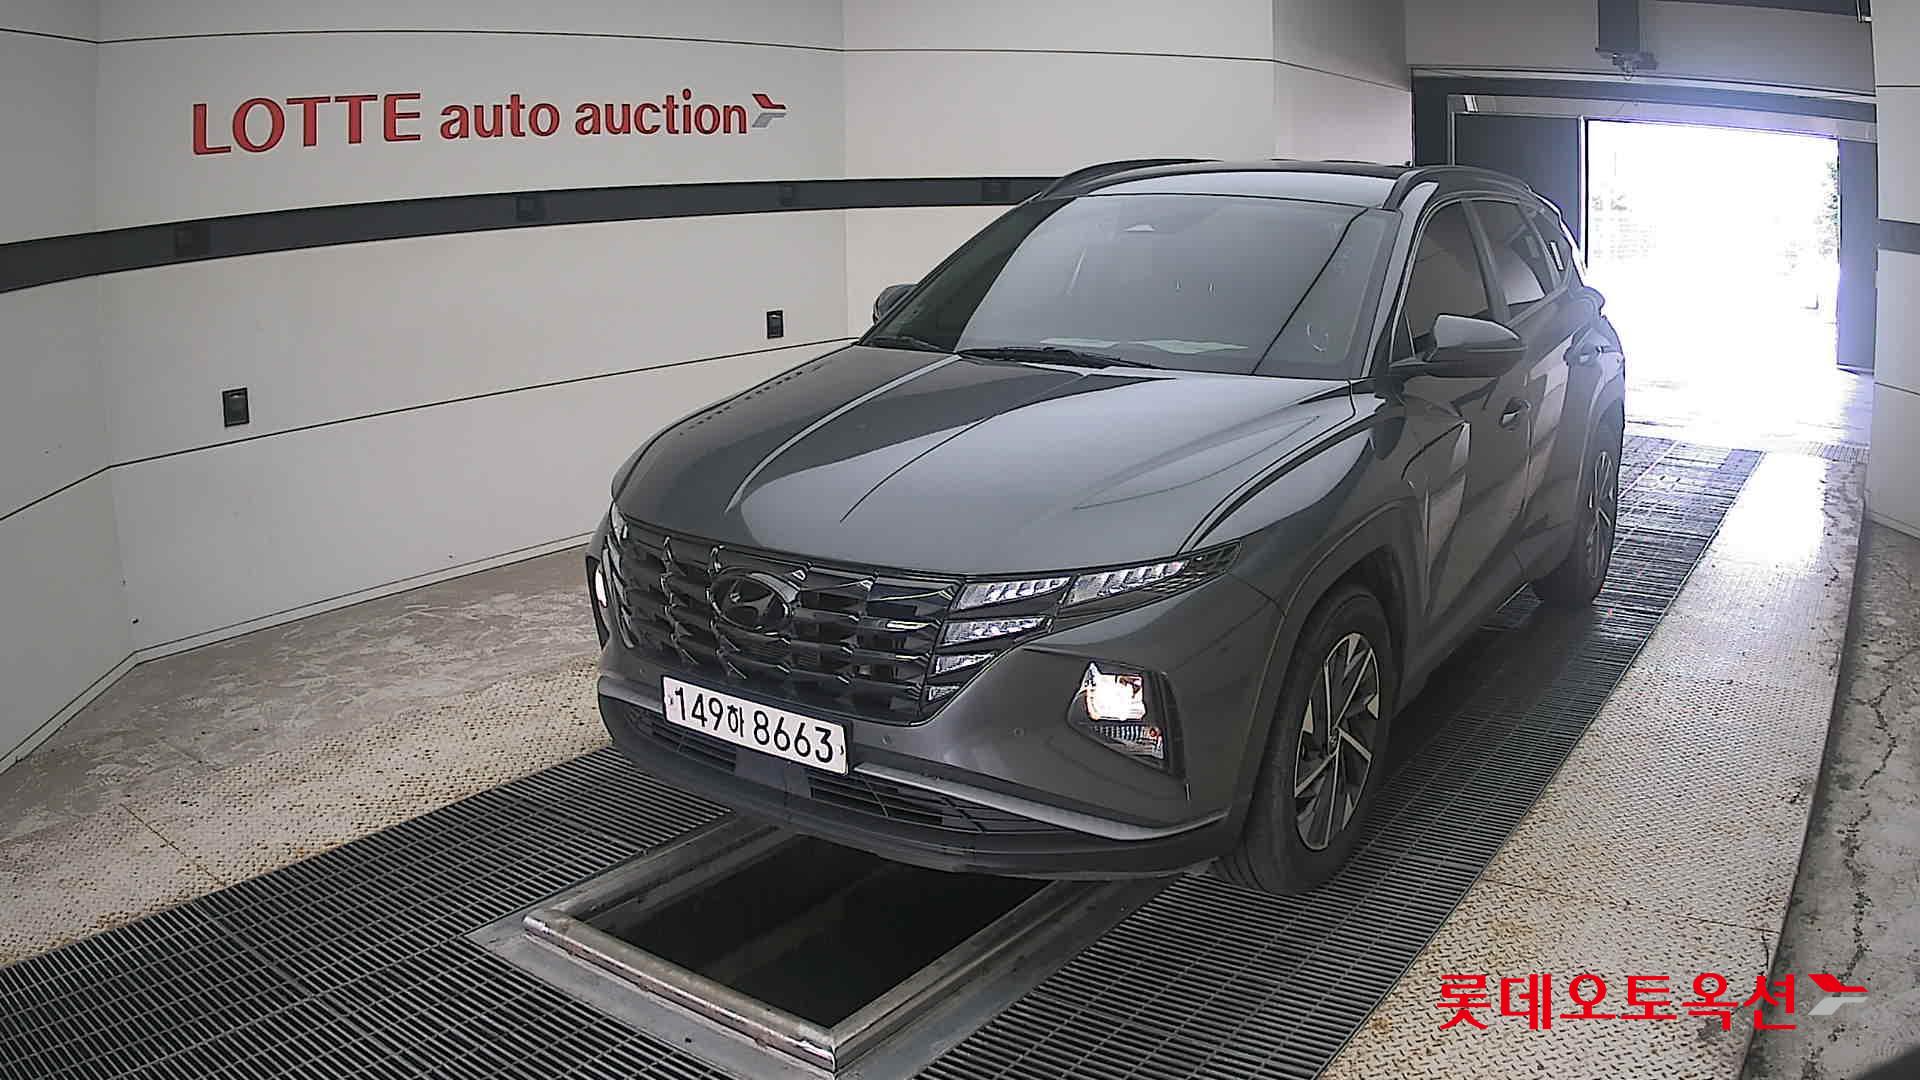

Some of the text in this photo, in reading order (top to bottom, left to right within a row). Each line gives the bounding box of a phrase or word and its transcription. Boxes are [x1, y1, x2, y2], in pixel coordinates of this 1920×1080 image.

[192, 88, 748, 156] LOTTE auto auction
[674, 687, 834, 763] 149하 8663
